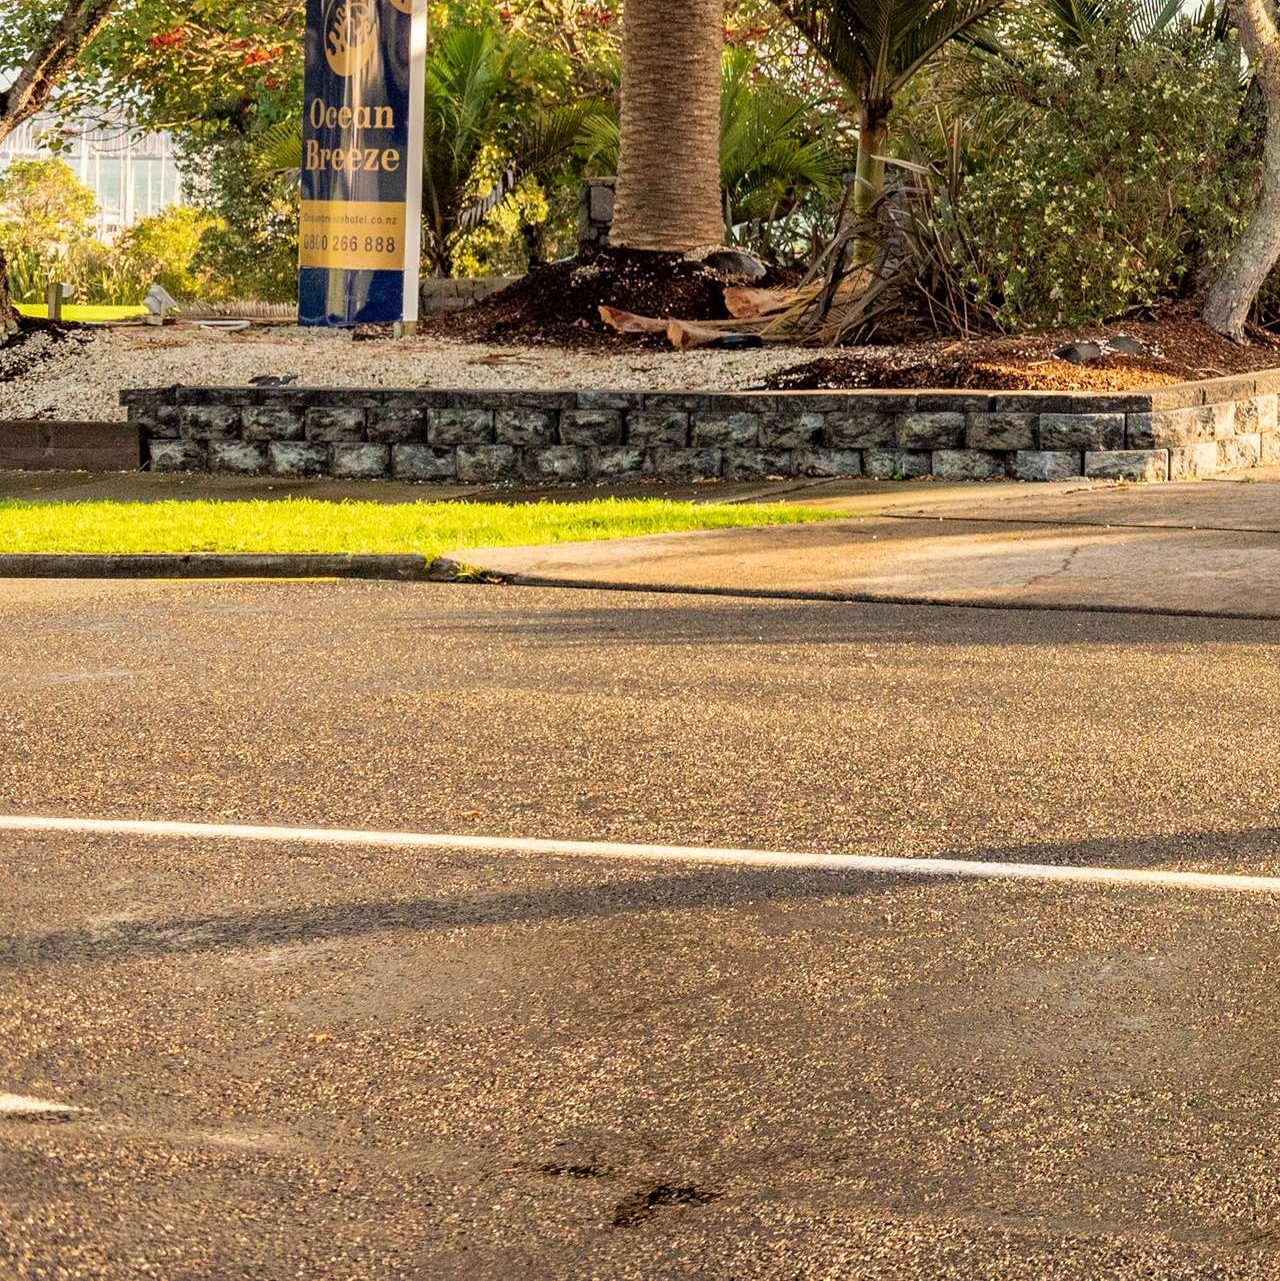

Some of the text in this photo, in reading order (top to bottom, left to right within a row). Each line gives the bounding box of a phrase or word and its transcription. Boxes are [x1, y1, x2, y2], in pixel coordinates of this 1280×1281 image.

[310, 98, 395, 129] Ocean
[305, 139, 400, 172] Breeze
[304, 234, 395, 253] 0800 266 888
